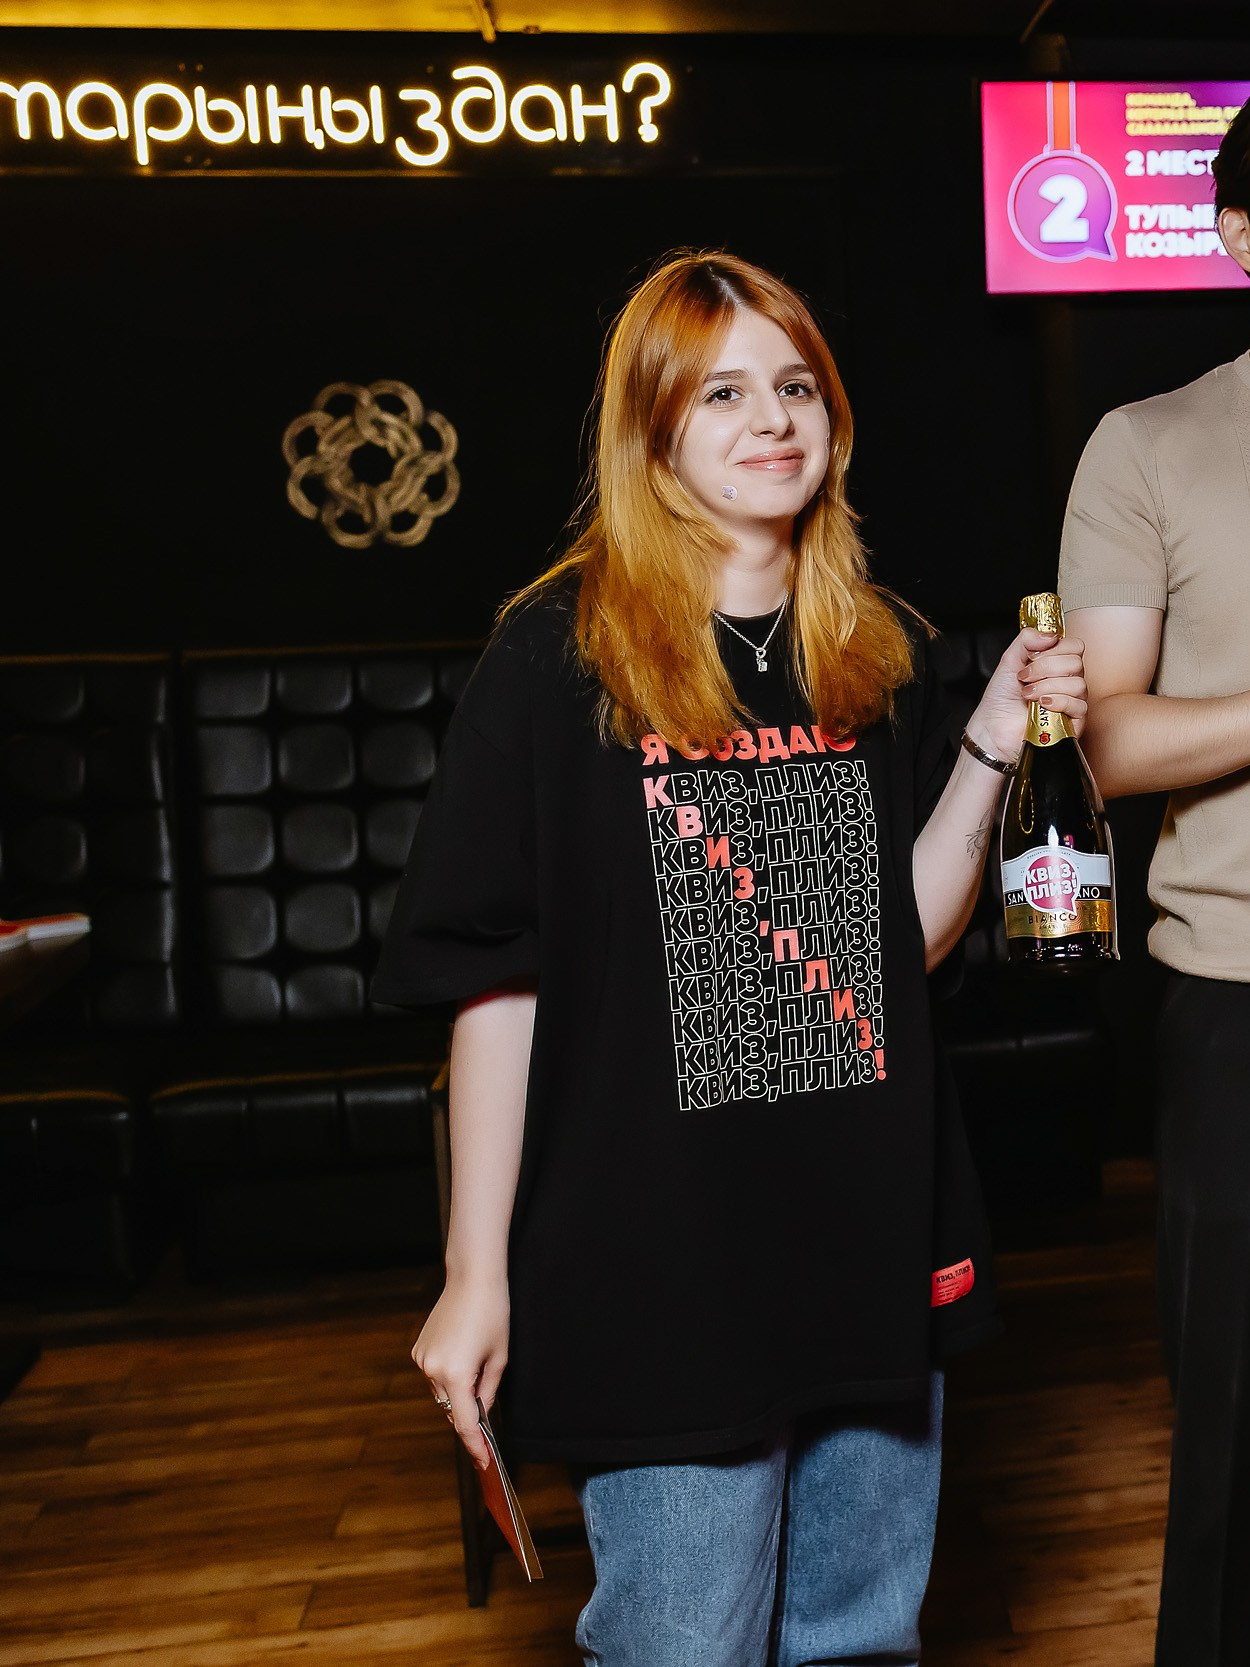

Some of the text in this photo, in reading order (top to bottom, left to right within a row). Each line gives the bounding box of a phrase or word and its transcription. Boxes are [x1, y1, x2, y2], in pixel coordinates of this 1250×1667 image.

[1125, 149, 1145, 176] 2
[1038, 174, 1090, 243] 2
[641, 734, 669, 766] Я
